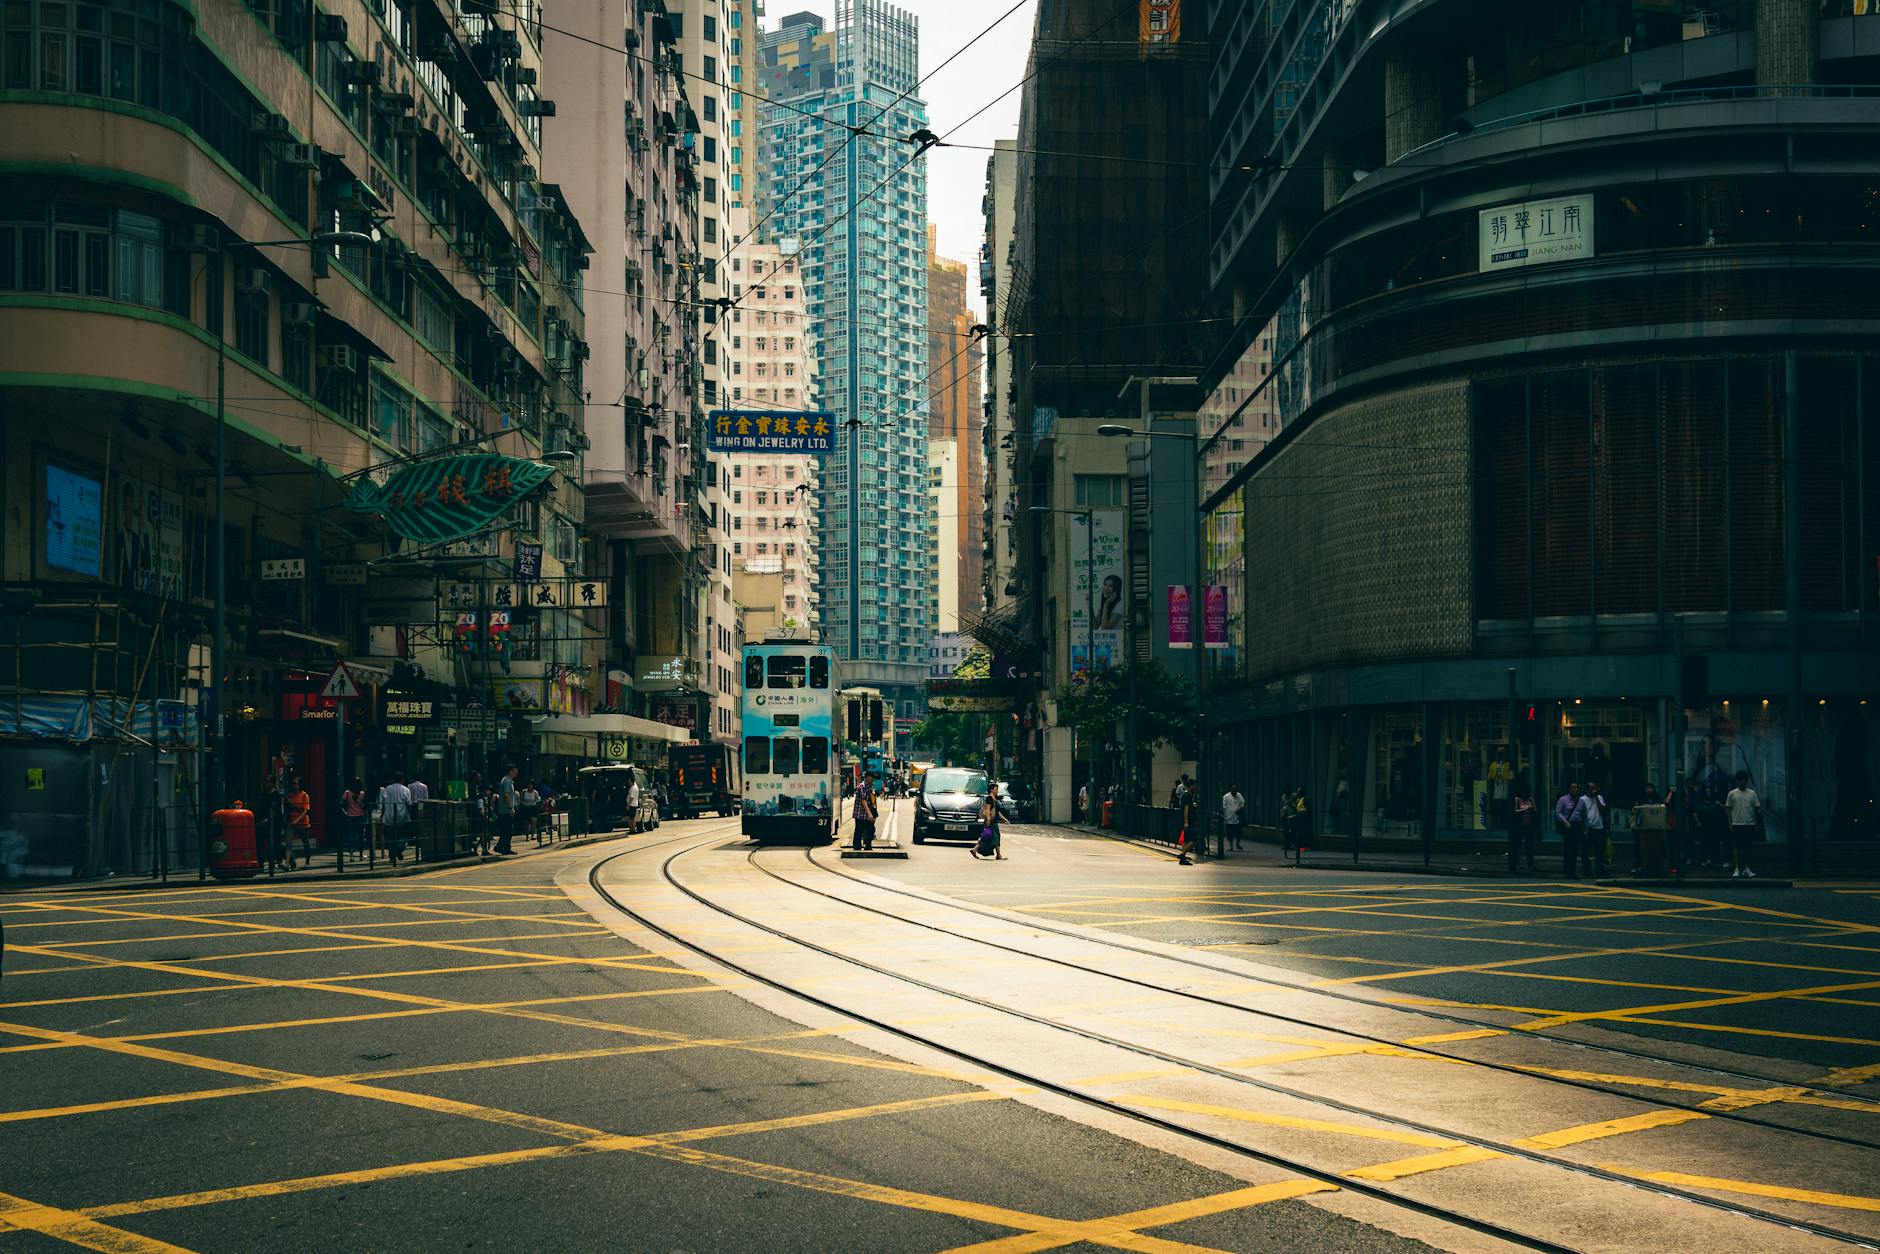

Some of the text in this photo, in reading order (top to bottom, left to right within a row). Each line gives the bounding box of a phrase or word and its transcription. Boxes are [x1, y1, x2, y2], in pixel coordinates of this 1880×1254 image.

[1491, 206, 1581, 244] 翡翠江南
[1531, 246, 1558, 257] JIANG
[1561, 243, 1582, 253] NAN
[716, 437, 829, 449] WING ON JEWELRY LTD.
[778, 627, 797, 638] 37
[671, 658, 683, 680] 永安
[386, 702, 433, 714] 萬福珠寶
[817, 818, 828, 826] 37
